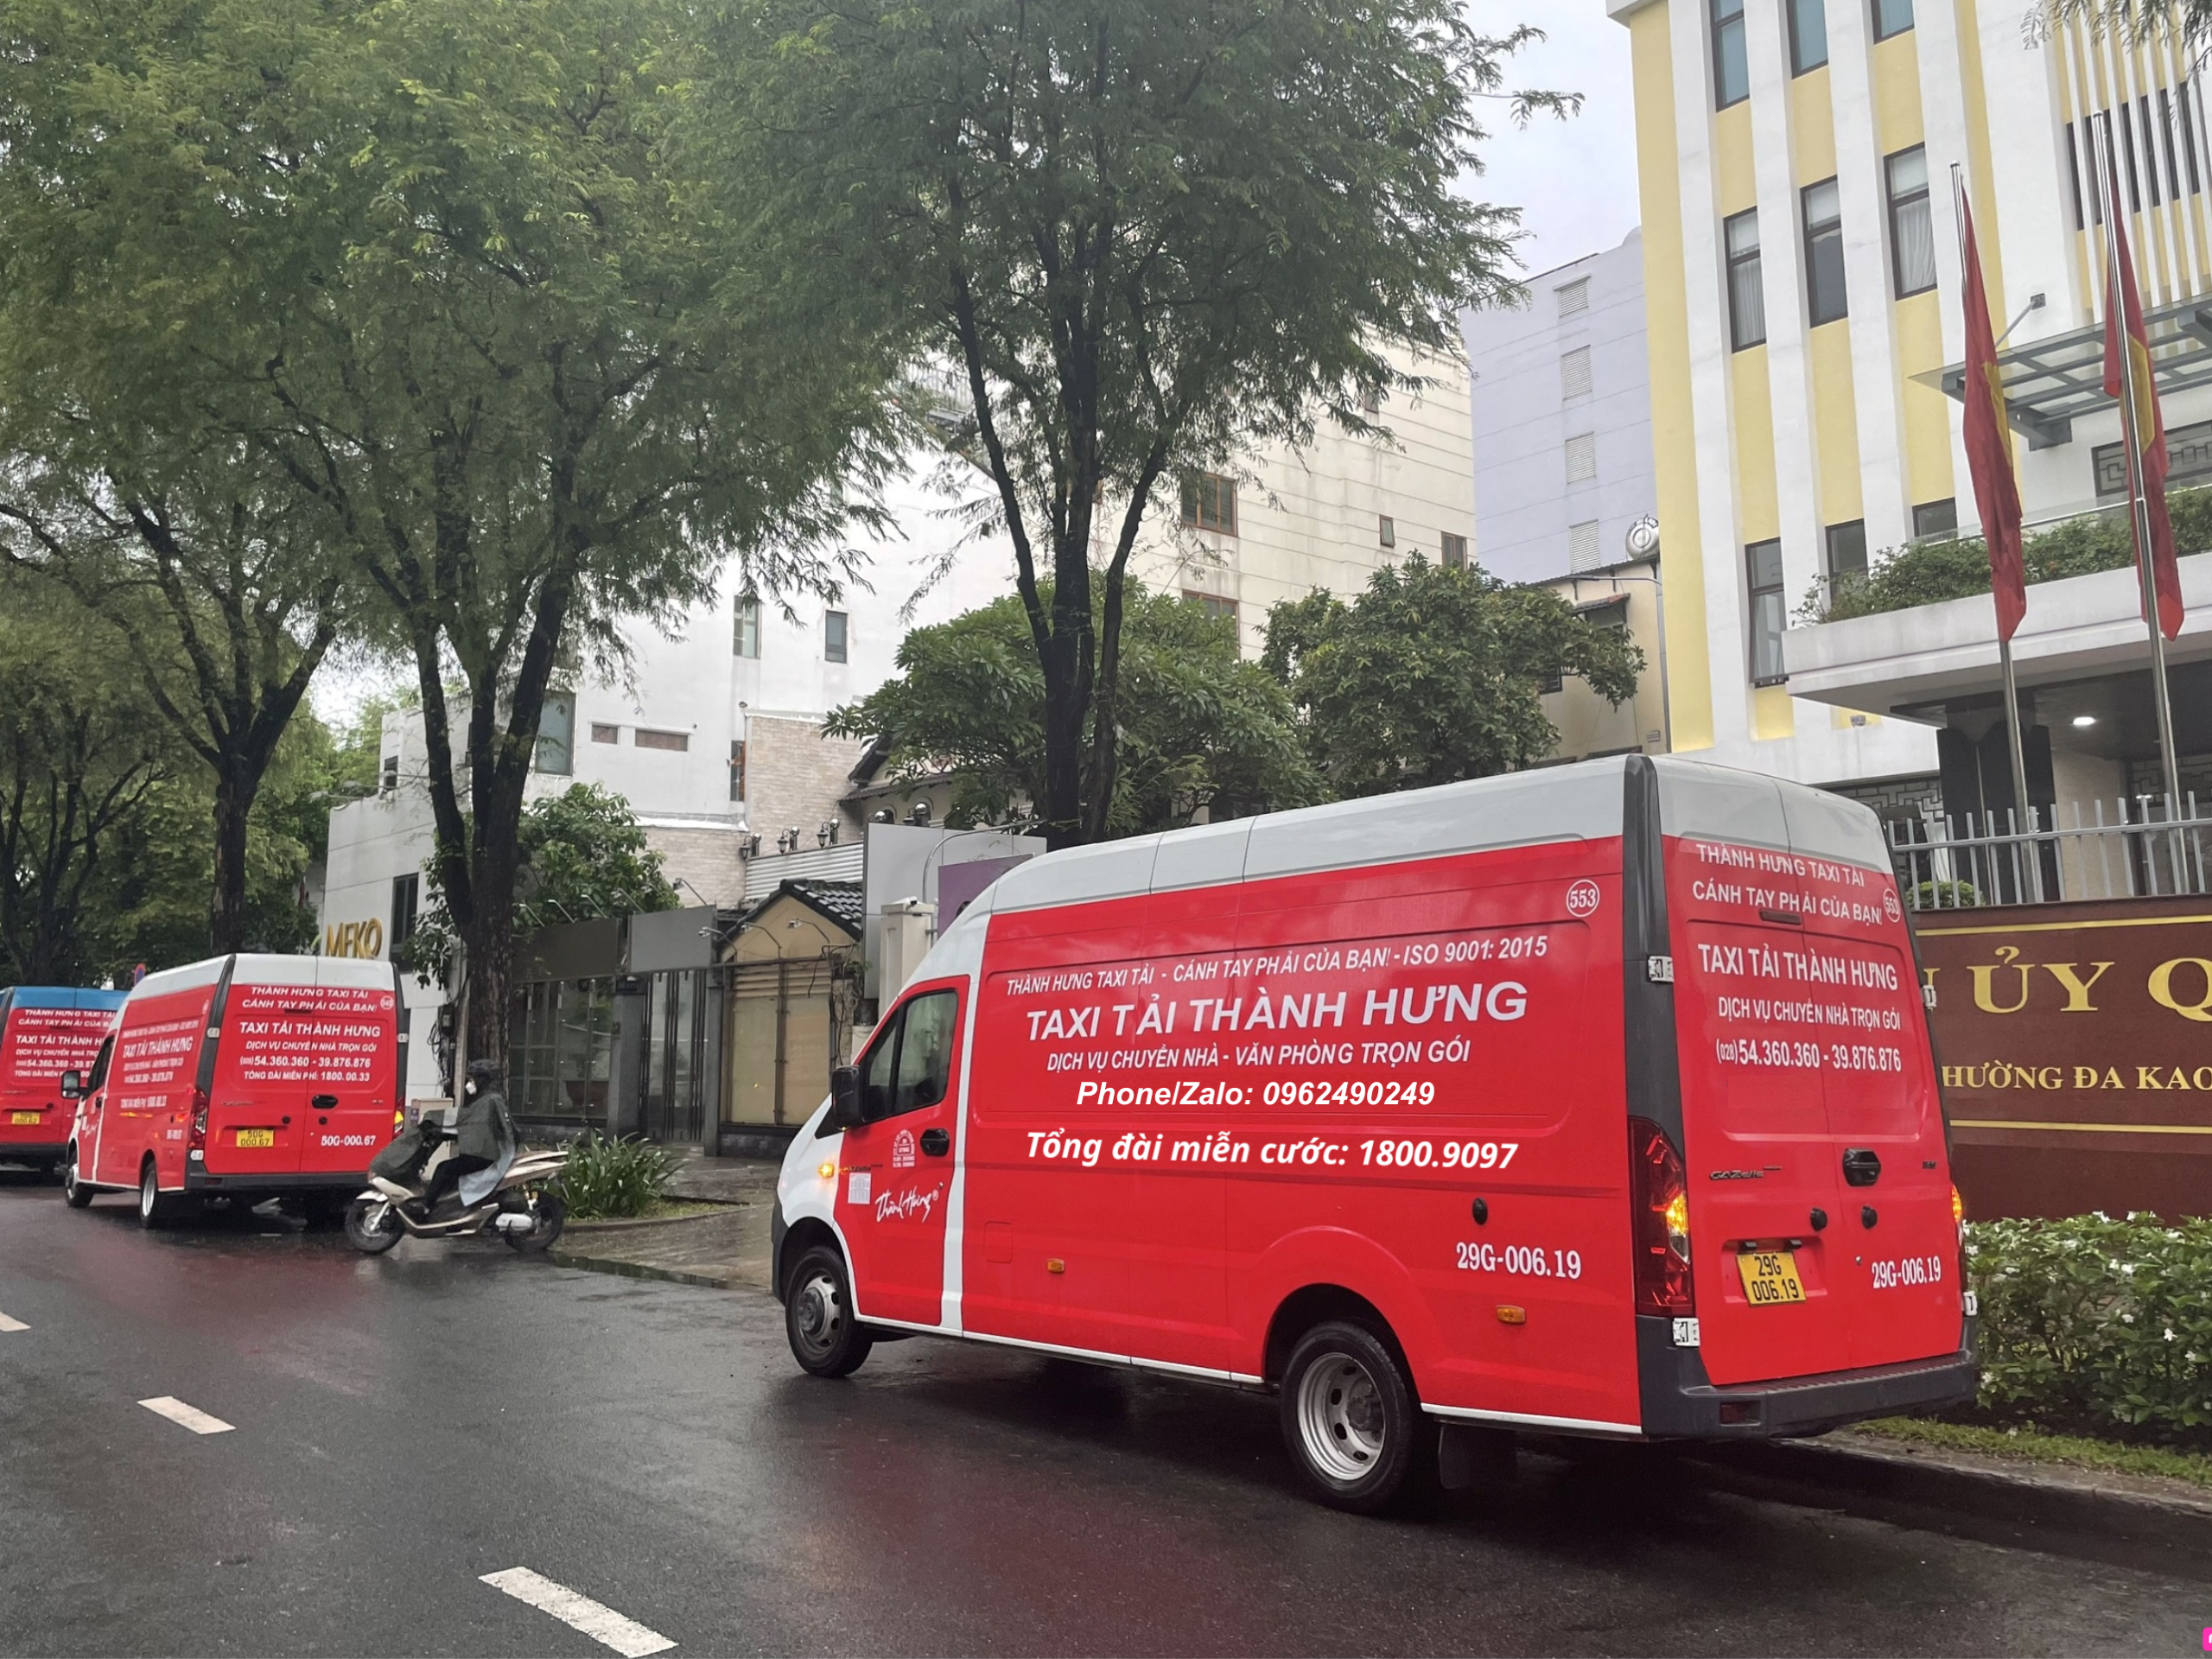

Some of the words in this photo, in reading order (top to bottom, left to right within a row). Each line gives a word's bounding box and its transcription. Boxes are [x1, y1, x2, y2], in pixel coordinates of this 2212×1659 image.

[1696, 842, 1755, 869] THÀNH
[1759, 854, 1806, 876] HƯNG
[1808, 861, 1840, 883] TAXI
[1570, 888, 1597, 909] 553
[1693, 878, 1742, 905] CÁNH
[1745, 887, 1776, 908] TAY
[1779, 891, 1816, 914] PHẢI
[1820, 895, 1851, 918] CỦA
[1007, 974, 1050, 995] THÀNH
[1052, 972, 1092, 991] HƯNG
[1096, 969, 1128, 988] TAXI
[1131, 963, 1155, 985] TẢI
[1173, 959, 1218, 982] CÁNH
[1223, 958, 1253, 978] TAY
[1255, 950, 1299, 975] PHẢI
[1303, 947, 1340, 972] CỦA
[1402, 944, 1440, 965] ISO
[1498, 935, 1548, 959] 2015
[1698, 944, 1744, 976] TAXI
[1748, 943, 1780, 979] TẢI
[1783, 948, 1847, 985] THÀNH
[1851, 959, 1897, 991] HƯNG
[1967, 945, 2115, 1014] ỦY
[277, 1001, 296, 1009] TAY
[327, 989, 350, 998] TAXI
[1027, 1006, 1101, 1040] TAXI
[1112, 994, 1177, 1036] TẢI
[1189, 986, 1347, 1033] THÀNH
[1362, 981, 1528, 1026] HƯNG
[1718, 996, 1750, 1022] DỊCH
[1753, 999, 1771, 1024] VỤ
[1773, 998, 1822, 1023] CHUYỂN
[1826, 1002, 1849, 1026] NHÀ
[1851, 1007, 1880, 1032] TRỌN
[1882, 1007, 1901, 1031] GÓI
[16, 1035, 38, 1044] TAXI
[239, 1021, 269, 1033] TAXI
[272, 1020, 292, 1034] TẢI
[296, 1021, 341, 1036] THÀNH
[343, 1025, 381, 1037] HƯNG
[318, 1057, 371, 1068] 39.876.876
[1046, 1052, 1084, 1073] DỊCH
[1087, 1051, 1109, 1073] VỤ
[1111, 1044, 1179, 1069] CHUYỂN
[1183, 1042, 1218, 1067] NHÀ
[1235, 1042, 1274, 1066] VĂN
[1278, 1039, 1354, 1065] PHÒNG
[1361, 1041, 1421, 1068] TRỌN
[1427, 1034, 1471, 1062] GÓI
[1832, 1046, 1902, 1072] 39.876.876
[1942, 1059, 2063, 1090] HƯỜNG
[2073, 1066, 2126, 1090] ĐA
[321, 1135, 376, 1147] 50G-000.67
[1456, 1242, 1582, 1280] 29G-006.19
[1753, 1254, 1783, 1277] 29G
[1871, 1255, 1942, 1289] 29G-006.19
[1751, 1277, 1800, 1302] 006.19
